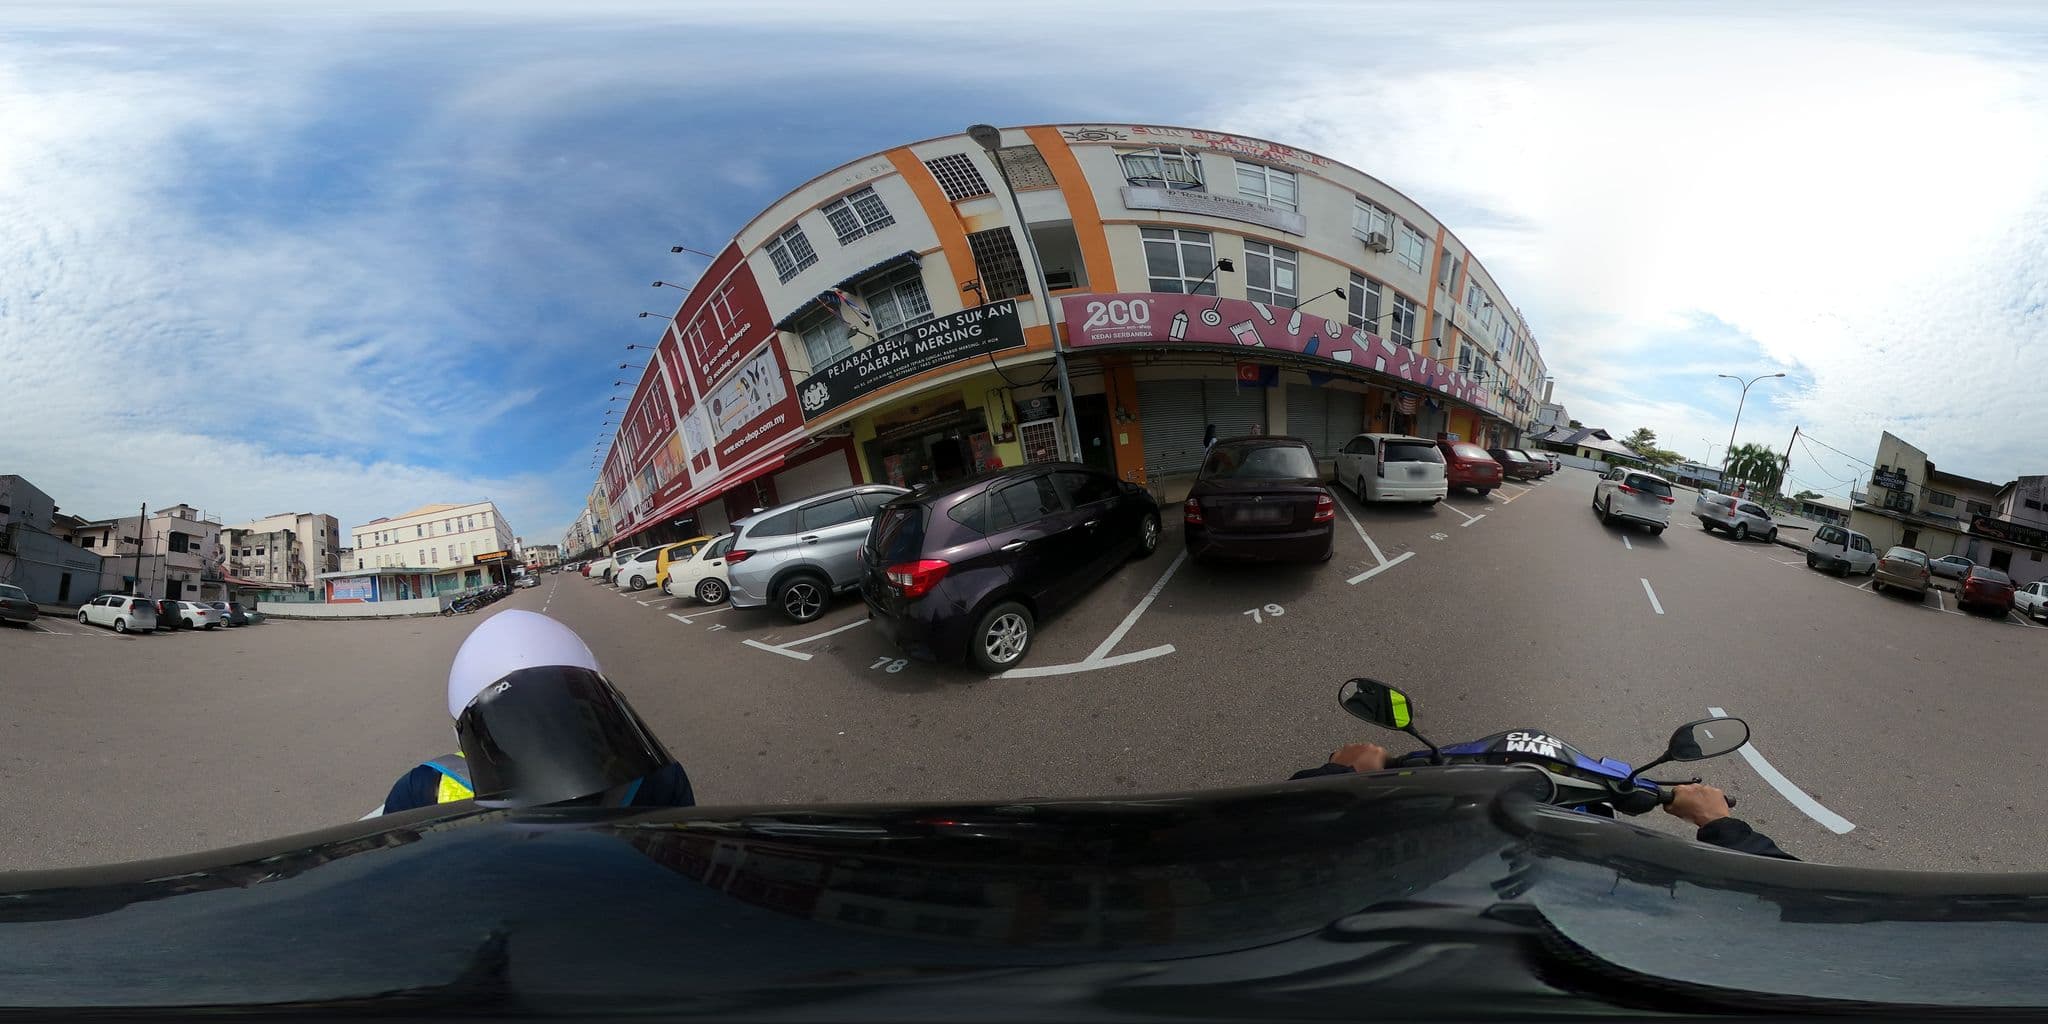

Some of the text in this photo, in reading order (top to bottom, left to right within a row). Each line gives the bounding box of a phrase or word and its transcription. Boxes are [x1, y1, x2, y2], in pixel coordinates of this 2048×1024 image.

[1131, 126, 1185, 138] SUN
[1192, 130, 1260, 147] BEACH
[709, 322, 751, 366] eco-shop Malaysia
[828, 349, 873, 379] PEJABAT
[918, 319, 951, 339] DAN
[956, 303, 1013, 326] SUKAN
[1092, 332, 1112, 341] KEDAI
[859, 325, 983, 377] DAERAH MERSING
[723, 413, 785, 456] www.eco-shop.com.my
[1243, 603, 1285, 625] 79
[869, 656, 909, 674] 78
[1506, 732, 1562, 749] 5713
[1506, 741, 1557, 758] WYM
